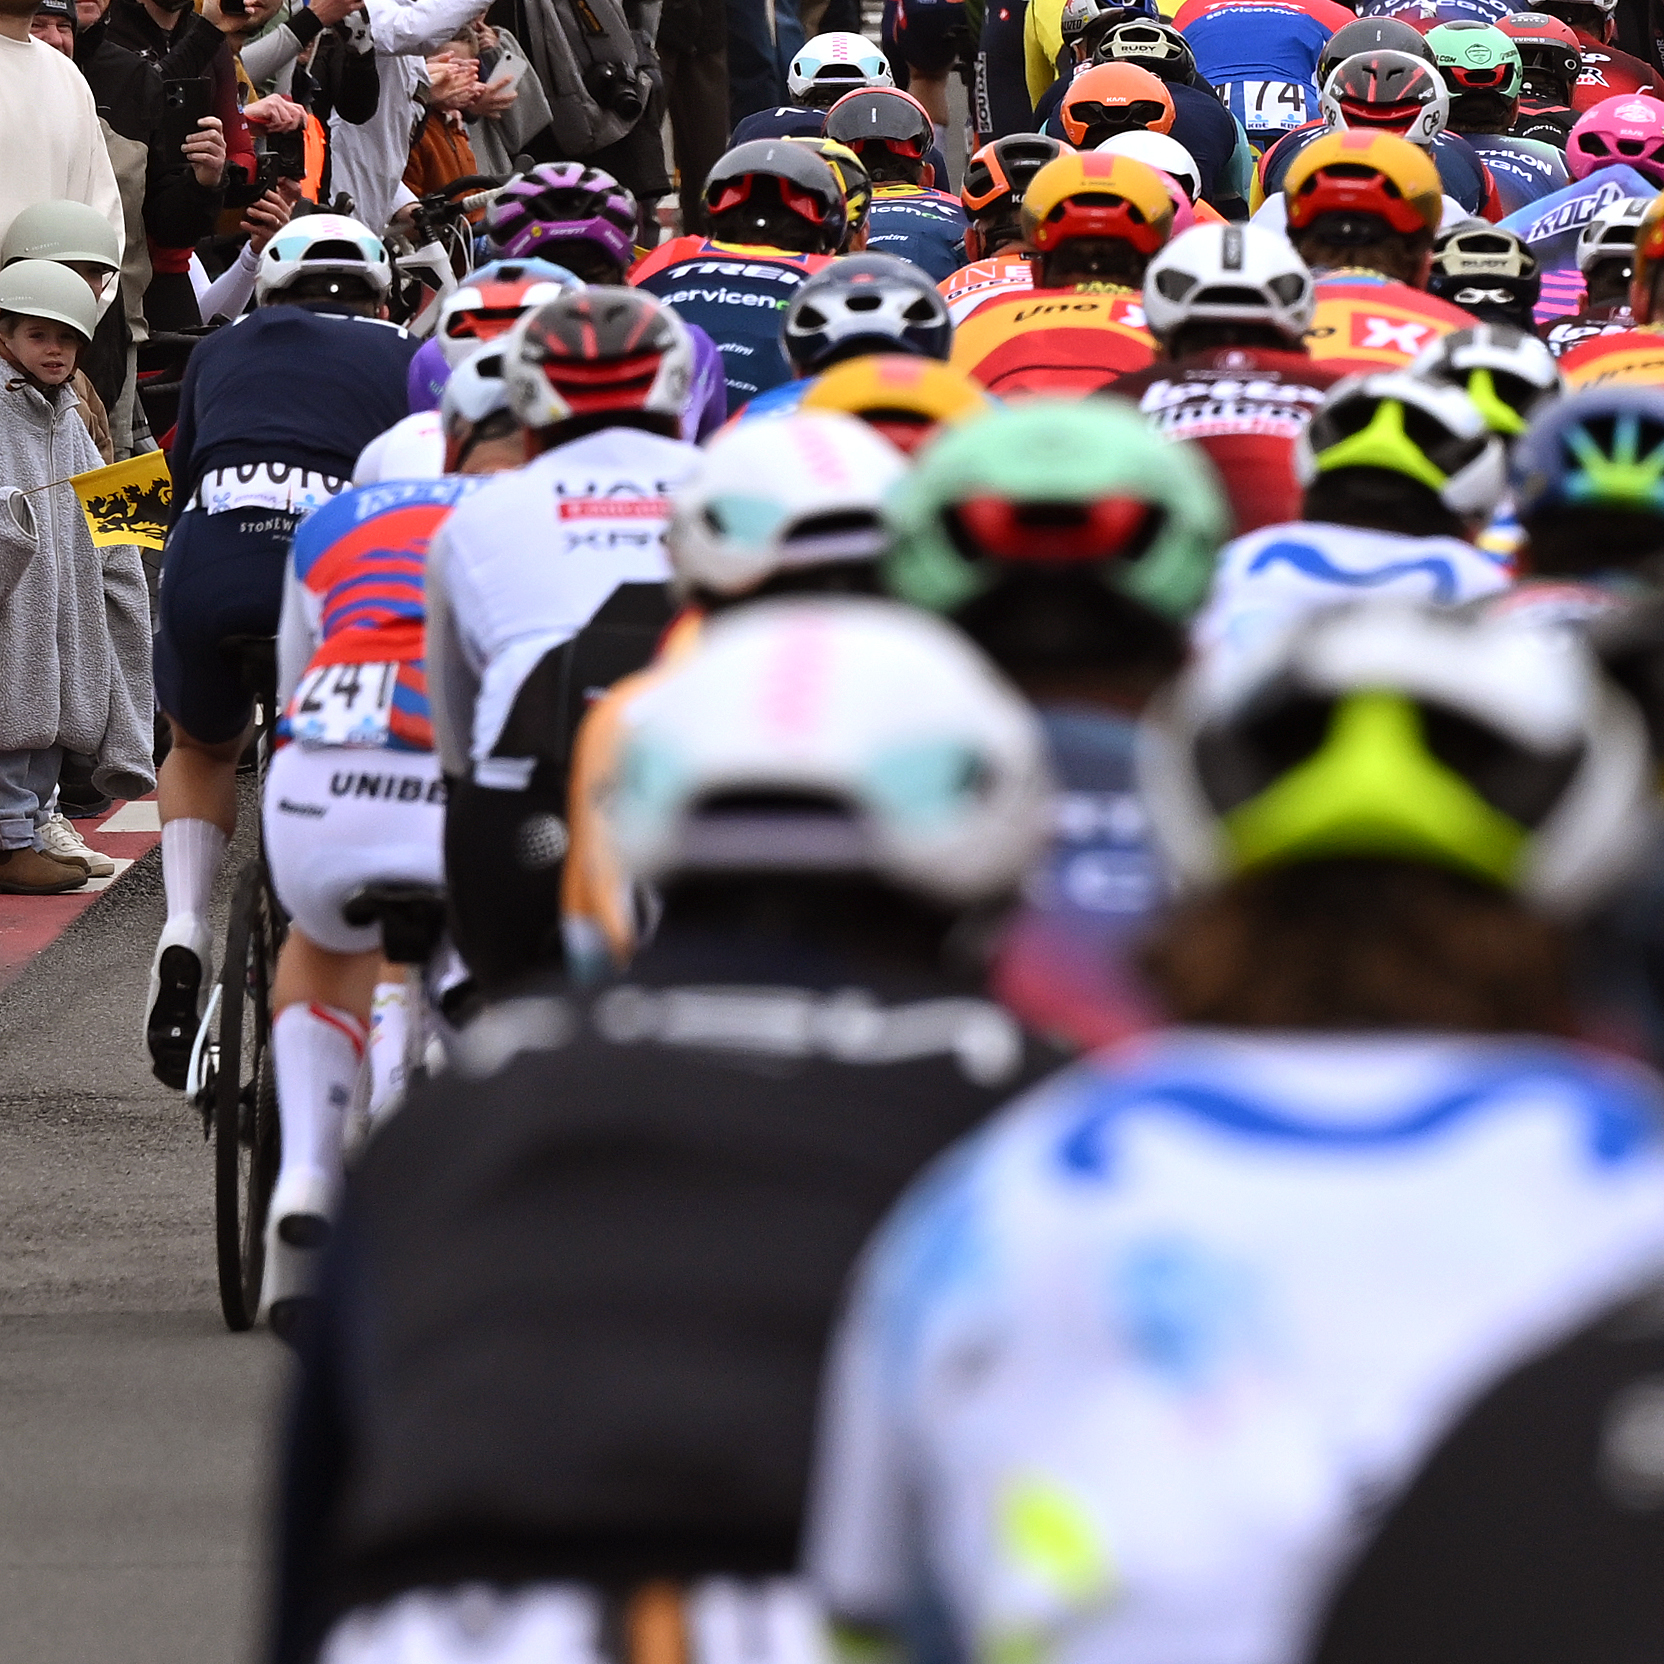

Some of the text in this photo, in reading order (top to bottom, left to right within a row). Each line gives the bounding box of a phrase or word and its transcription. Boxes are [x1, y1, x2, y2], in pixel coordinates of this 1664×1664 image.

[1255, 80, 1304, 113] 74
[1475, 150, 1552, 176] THLON
[948, 264, 1033, 290] INE
[661, 287, 792, 310] serviceno
[239, 519, 295, 533] STONEW
[300, 663, 391, 714] 241
[330, 771, 447, 805] UNIBE
